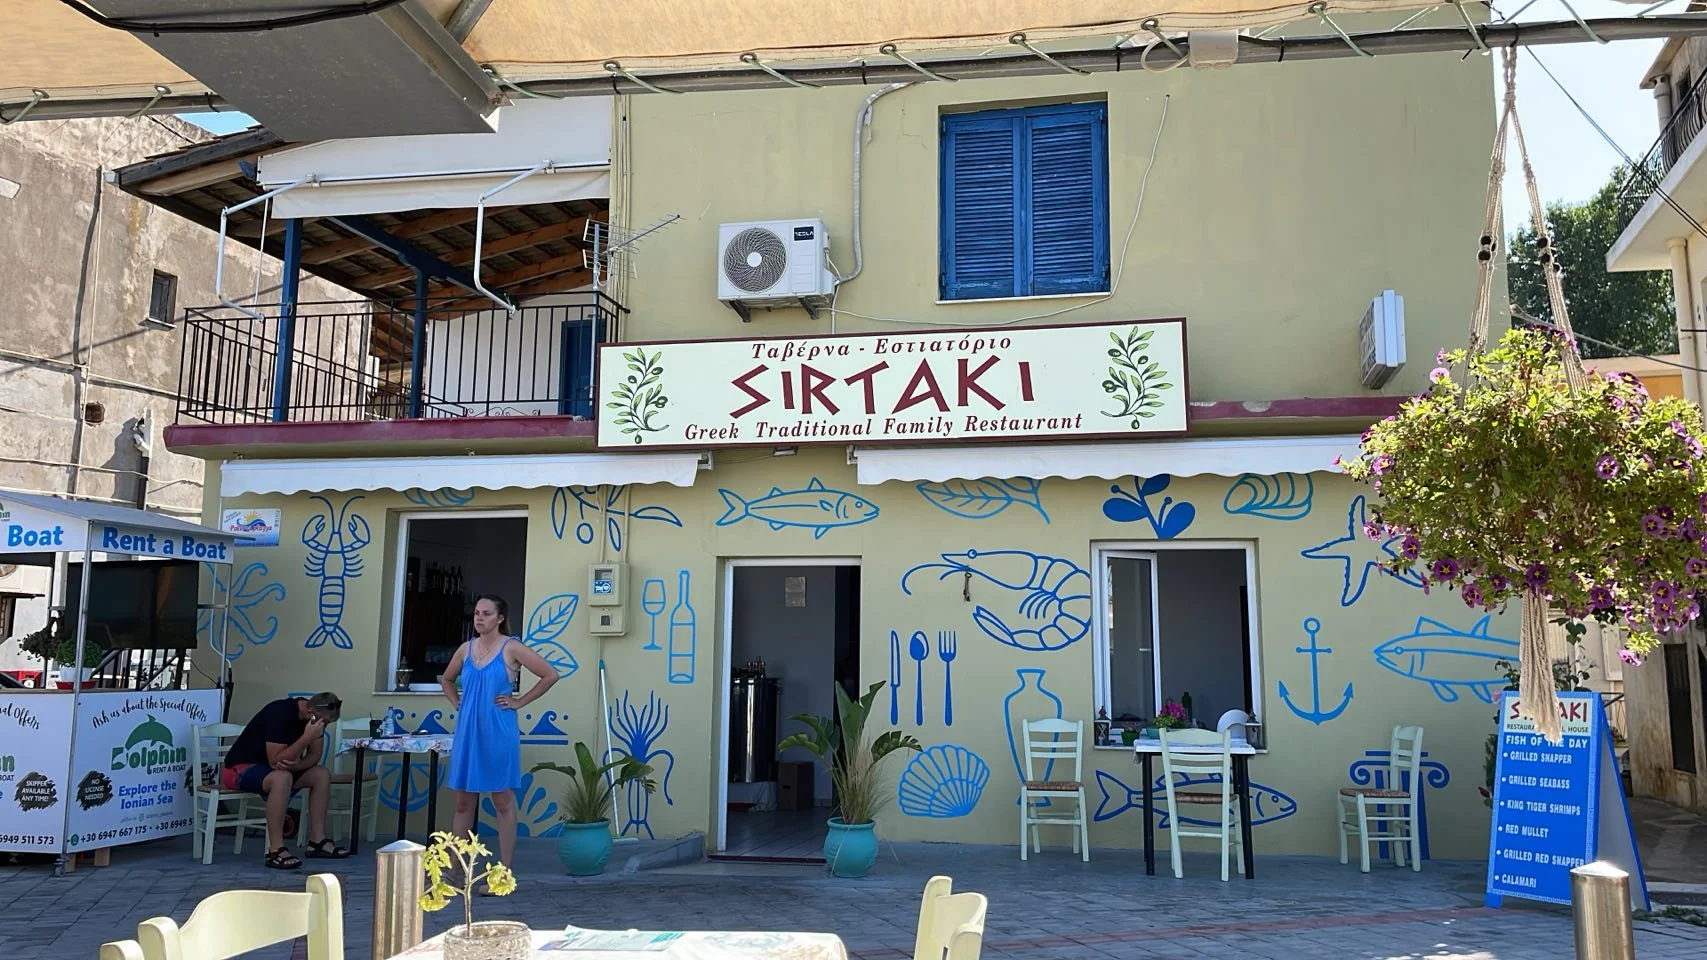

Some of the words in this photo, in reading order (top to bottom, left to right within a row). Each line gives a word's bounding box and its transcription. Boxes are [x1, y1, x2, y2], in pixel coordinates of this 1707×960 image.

[752, 341, 850, 361] Ταβέρνα
[874, 334, 1012, 354] Εστιατόριο
[729, 355, 1035, 419] SIRTAKI
[684, 422, 740, 440] Greek
[756, 418, 872, 438] Traditional
[882, 415, 953, 437] Family
[964, 412, 1084, 432] Restaurant
[8, 525, 64, 547] Boat
[102, 526, 156, 552] Rent
[162, 540, 174, 554] a
[181, 536, 226, 560] Boat
[14, 707, 40, 730] Offers
[92, 710, 110, 728] Ask
[110, 710, 120, 718] us
[122, 699, 144, 714] about
[146, 696, 158, 710] the
[160, 698, 186, 712] Special
[186, 702, 208, 722] Offers
[1506, 735, 1526, 745] FISH
[1530, 736, 1543, 746] OF
[1568, 739, 1588, 748] DAY
[111, 744, 187, 775] Dolphin
[1510, 752, 1538, 762] GRILLED
[1541, 753, 1572, 764] SNAPPER
[152, 766, 166, 774] RENT
[172, 764, 187, 772] BOAT
[118, 783, 158, 798] Explore
[160, 780, 177, 791] the
[1508, 775, 1536, 786] GRILLED
[1540, 777, 1570, 789] SEABASS
[120, 798, 154, 810] Ionian
[156, 794, 174, 805] Sea
[1507, 800, 1524, 810] KING
[1526, 801, 1547, 812] TIGER
[1550, 803, 1581, 816] SHRIMPS
[81, 832, 96, 843] +30
[98, 830, 117, 840] 6947
[120, 826, 133, 837] 667
[134, 825, 147, 835] 175
[155, 822, 169, 831] +30
[170, 818, 187, 828] 6949
[1505, 824, 1518, 834] RED
[1521, 826, 1549, 838] MULLET
[21, 836, 34, 844] 511
[37, 836, 54, 845] 573
[1504, 849, 1532, 861] GRILLED
[1535, 852, 1549, 863] RED
[1552, 855, 1585, 868] SNAPPER
[1502, 874, 1537, 888] CALAMARI
